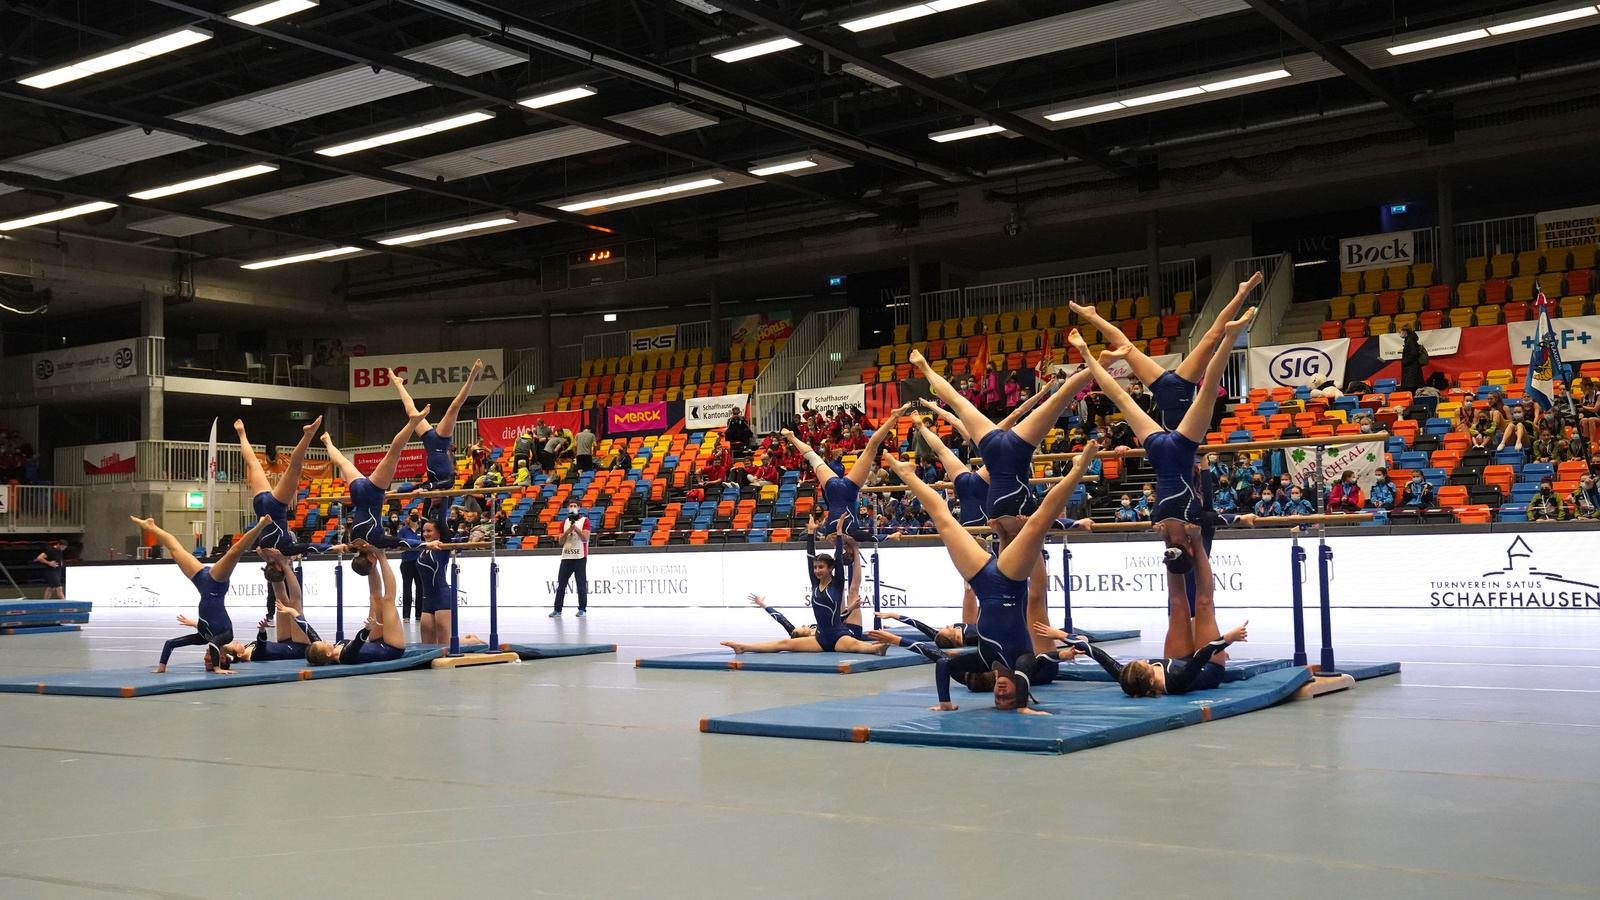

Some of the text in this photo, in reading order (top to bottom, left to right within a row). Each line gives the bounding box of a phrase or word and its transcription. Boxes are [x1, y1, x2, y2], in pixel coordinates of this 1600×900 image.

[1545, 226, 1596, 241] ELEKTRO
[1297, 235, 1334, 254] IWC
[1346, 238, 1410, 265] Bock
[632, 335, 676, 351] EKS
[1521, 329, 1592, 350] +F+
[412, 364, 499, 385] ARENA
[1280, 356, 1320, 379] SIG
[815, 395, 849, 403] Schaffhauser
[702, 403, 734, 411] Schaffhauser
[703, 409, 745, 419] Kantonal
[815, 402, 862, 412] Kantonalbank
[502, 427, 516, 439] die
[1295, 458, 1323, 484] HOP
[1125, 555, 1242, 569] JAKOB MMA
[612, 564, 688, 576] JAKOB UND EMMA
[546, 578, 688, 594] WNLER-STIFTUNG
[1047, 573, 1243, 592] INDLER-STING
[1430, 581, 1500, 589] TURNVEREIN
[1430, 592, 1600, 607] SCHAFFHAUSEN
